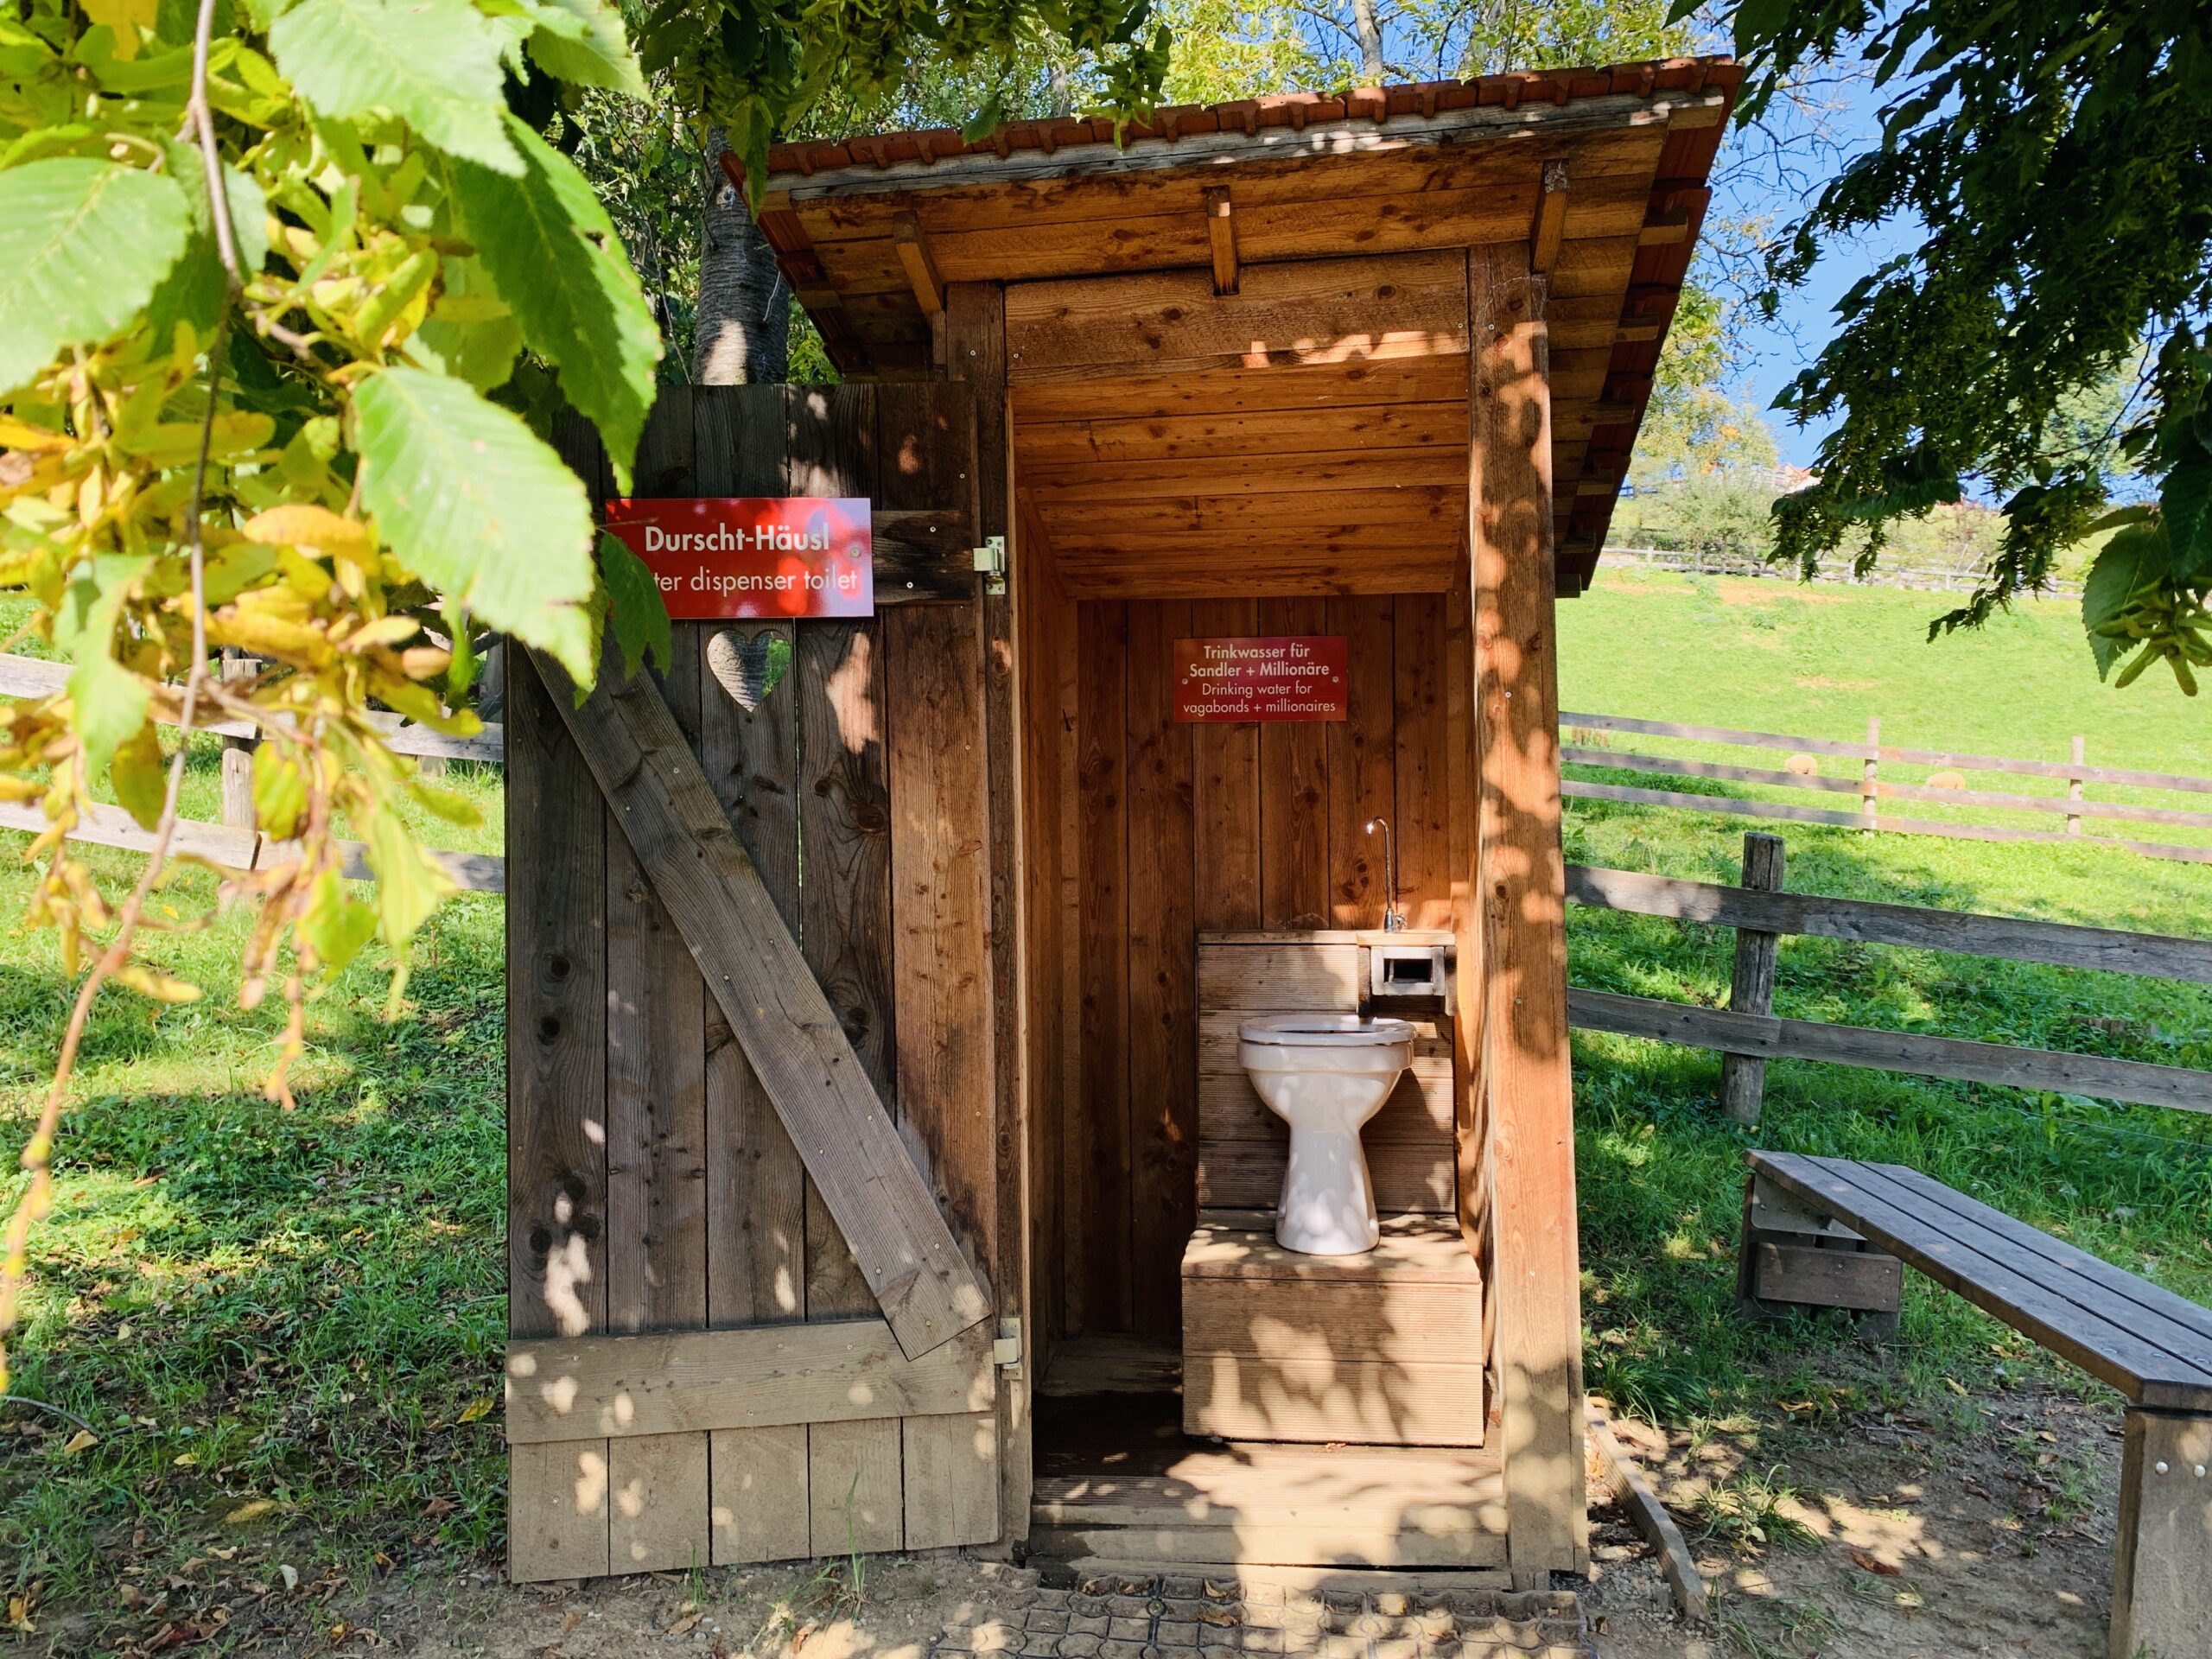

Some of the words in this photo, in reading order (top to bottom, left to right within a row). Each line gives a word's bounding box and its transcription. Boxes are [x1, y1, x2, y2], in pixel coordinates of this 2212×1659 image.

[645, 523, 829, 551] Durscht-Häusl
[653, 574, 682, 590] ter
[690, 567, 796, 596] dispenser
[804, 567, 856, 590] toilet
[1204, 645, 1286, 658] Trinkwasser
[1290, 643, 1310, 658] für
[1190, 662, 1241, 677] Sandler
[1246, 667, 1255, 676] +
[1260, 662, 1329, 676] Millionäre
[1203, 682, 1253, 698] Drinking
[1257, 684, 1291, 695] water
[1295, 680, 1313, 694] for
[1183, 699, 1249, 716] vagabonds
[1266, 698, 1335, 712] millionaires
